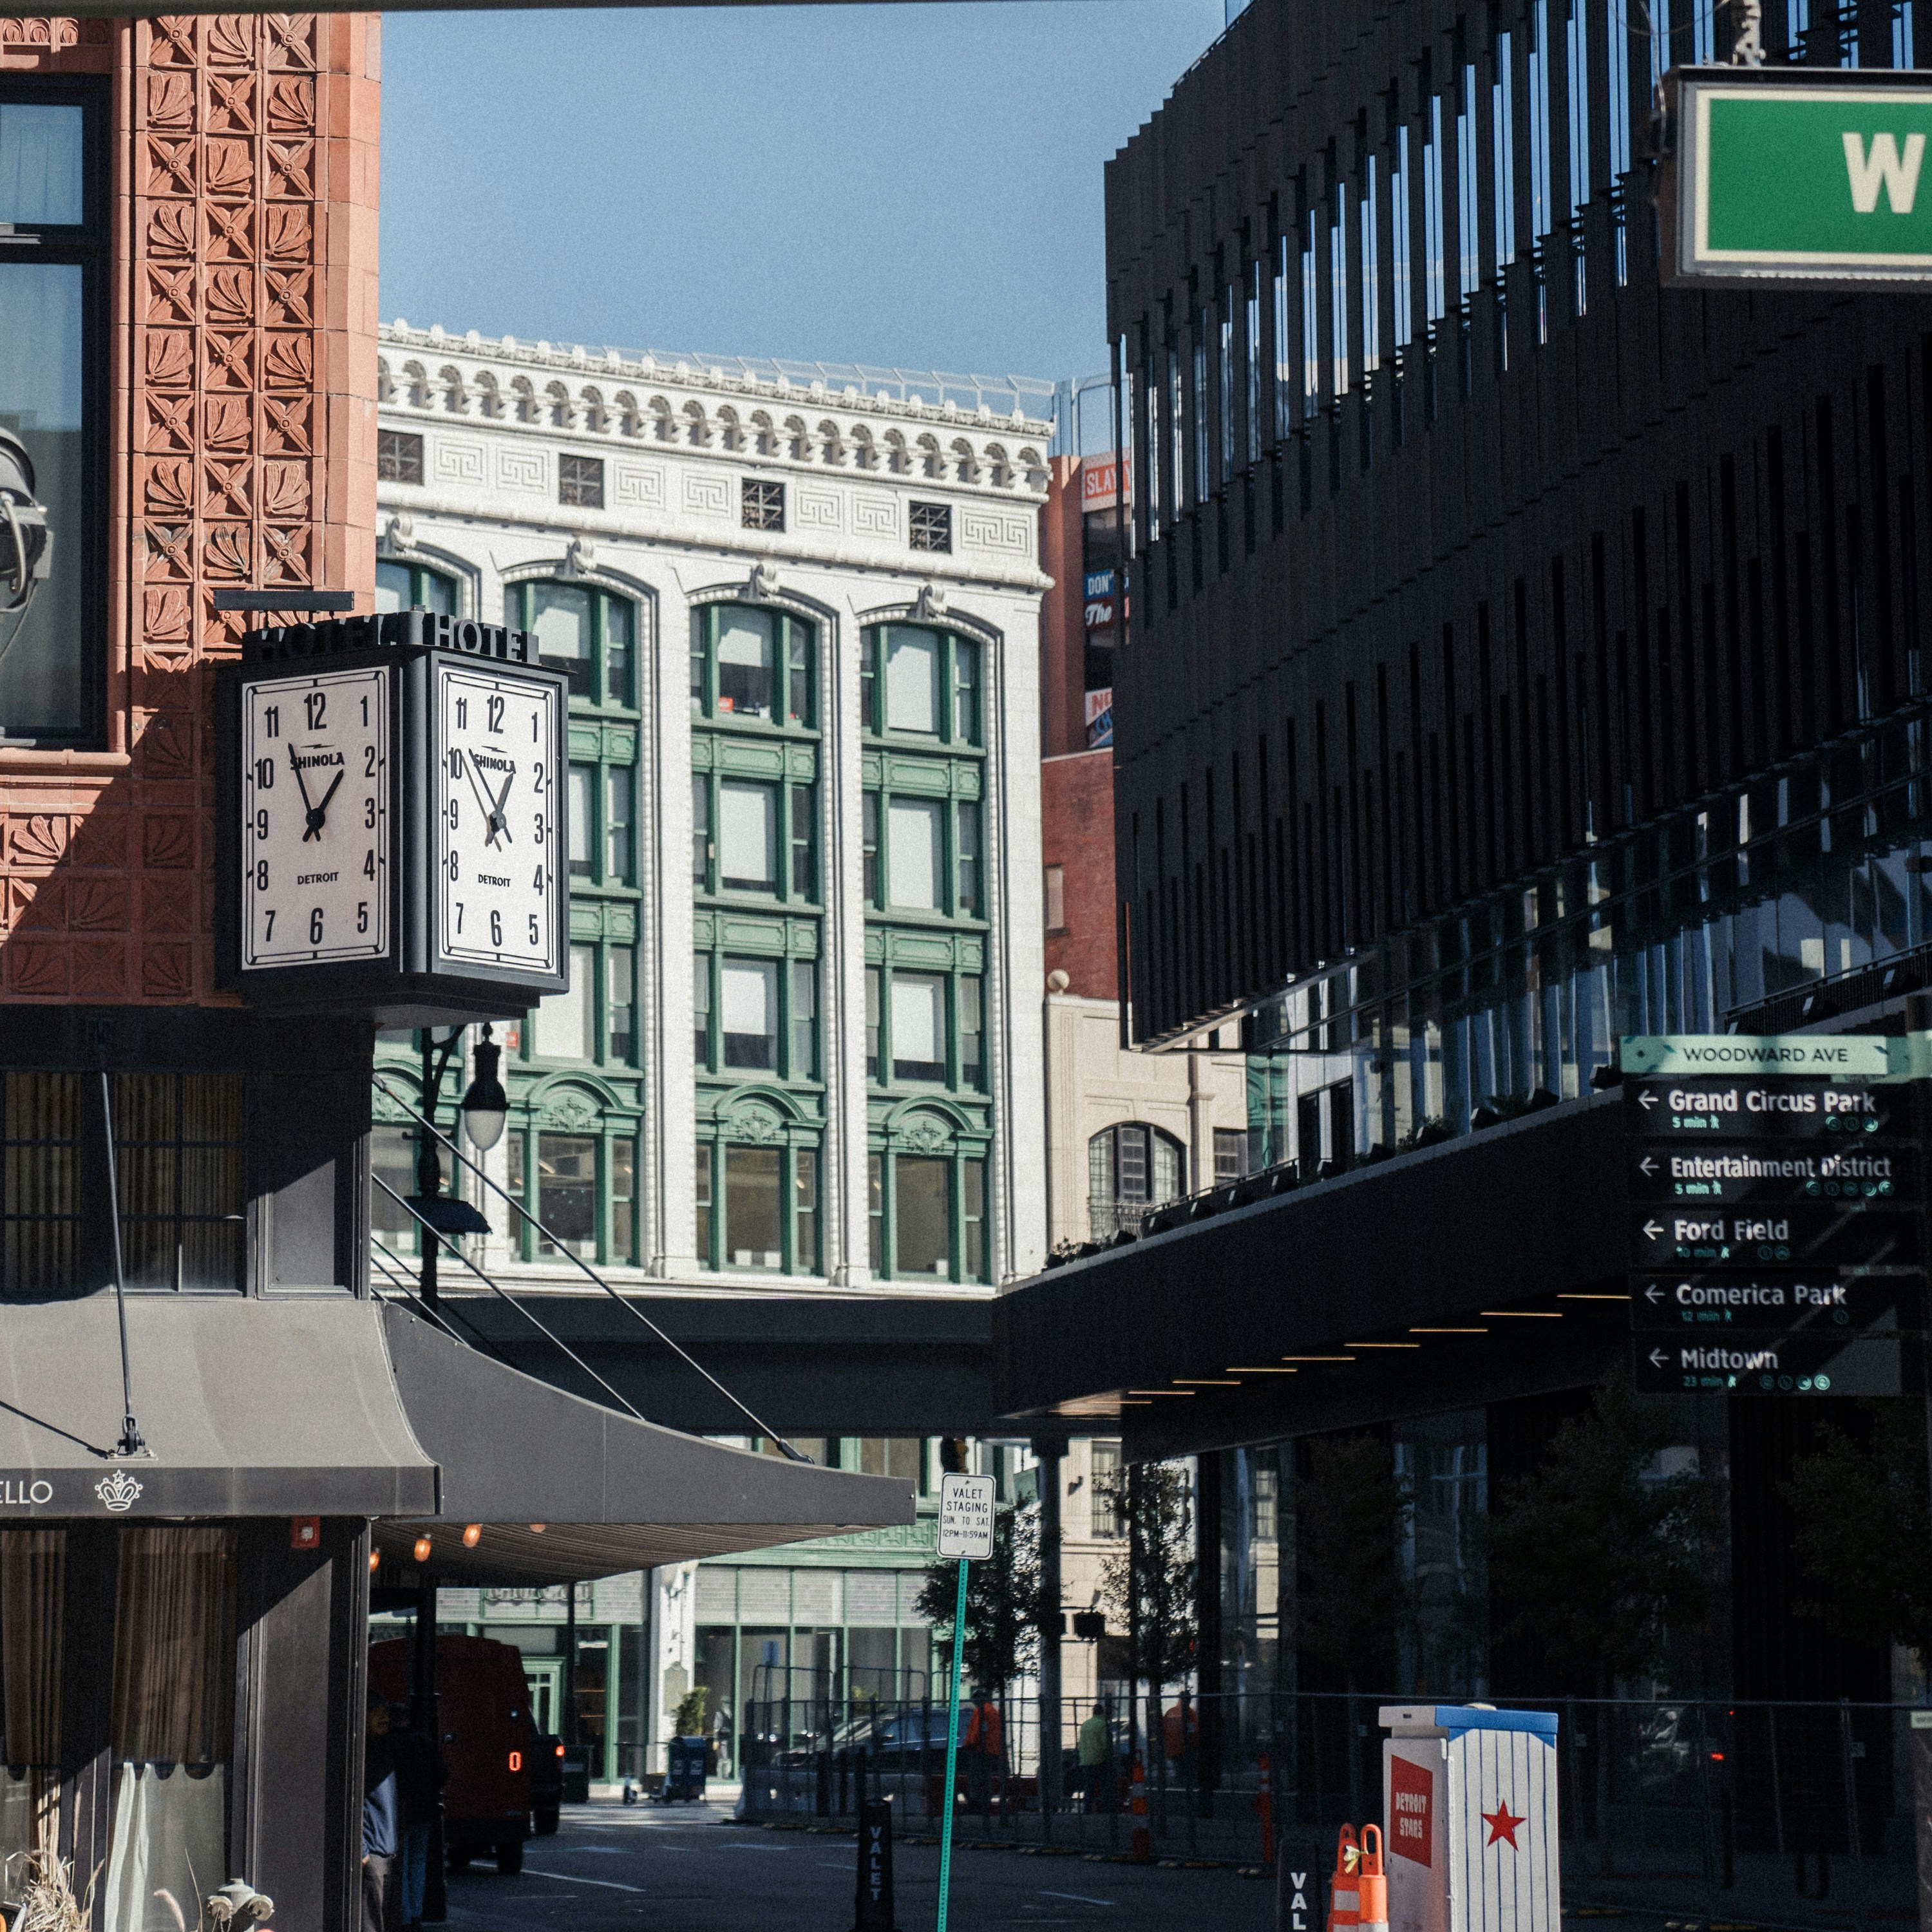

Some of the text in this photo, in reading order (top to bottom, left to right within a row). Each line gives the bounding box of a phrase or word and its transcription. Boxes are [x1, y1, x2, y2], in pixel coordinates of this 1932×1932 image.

[1842, 131, 1926, 214] W
[433, 612, 540, 665] HOTEL
[263, 706, 279, 738] 11
[303, 692, 327, 730] 12
[360, 695, 368, 727] 1
[456, 697, 468, 730] 11
[487, 694, 505, 734] 12
[531, 712, 538, 743] 1
[254, 757, 274, 790] 10
[290, 752, 345, 770] SHINOLA
[364, 745, 376, 778] 2
[448, 747, 462, 780] 10
[473, 753, 516, 774] SHINOLA
[534, 762, 544, 794] 2
[257, 808, 269, 840] 9
[365, 797, 375, 829] 3
[450, 799, 459, 830] 9
[534, 813, 544, 844] 3
[257, 859, 269, 891] 8
[297, 871, 339, 886] DETROIT
[363, 849, 375, 882] 4
[450, 849, 459, 882] 8
[478, 873, 511, 888] DETROIT
[533, 864, 545, 896] 4
[265, 909, 276, 942] 7
[309, 907, 324, 945] 6
[357, 901, 368, 934] 5
[455, 902, 464, 934] 7
[490, 909, 503, 947] 6
[529, 913, 539, 945] 5
[1683, 1047, 1849, 1063] WOODWARD AVE
[1668, 1089, 1877, 1113] Grand Circus Park
[1671, 1155, 1891, 1178] Entertainment District
[1674, 1219, 1789, 1241] Ford Field
[1676, 1283, 1847, 1305] Comerica Park
[1681, 1347, 1779, 1370] Midtown
[946, 1501, 988, 1513] STAGING
[953, 1488, 983, 1499] VALET
[962, 1517, 971, 1525] TO
[1396, 1792, 1427, 1814] DETROIT
[1399, 1817, 1423, 1839] STARS
[869, 1826, 882, 1900] VALET
